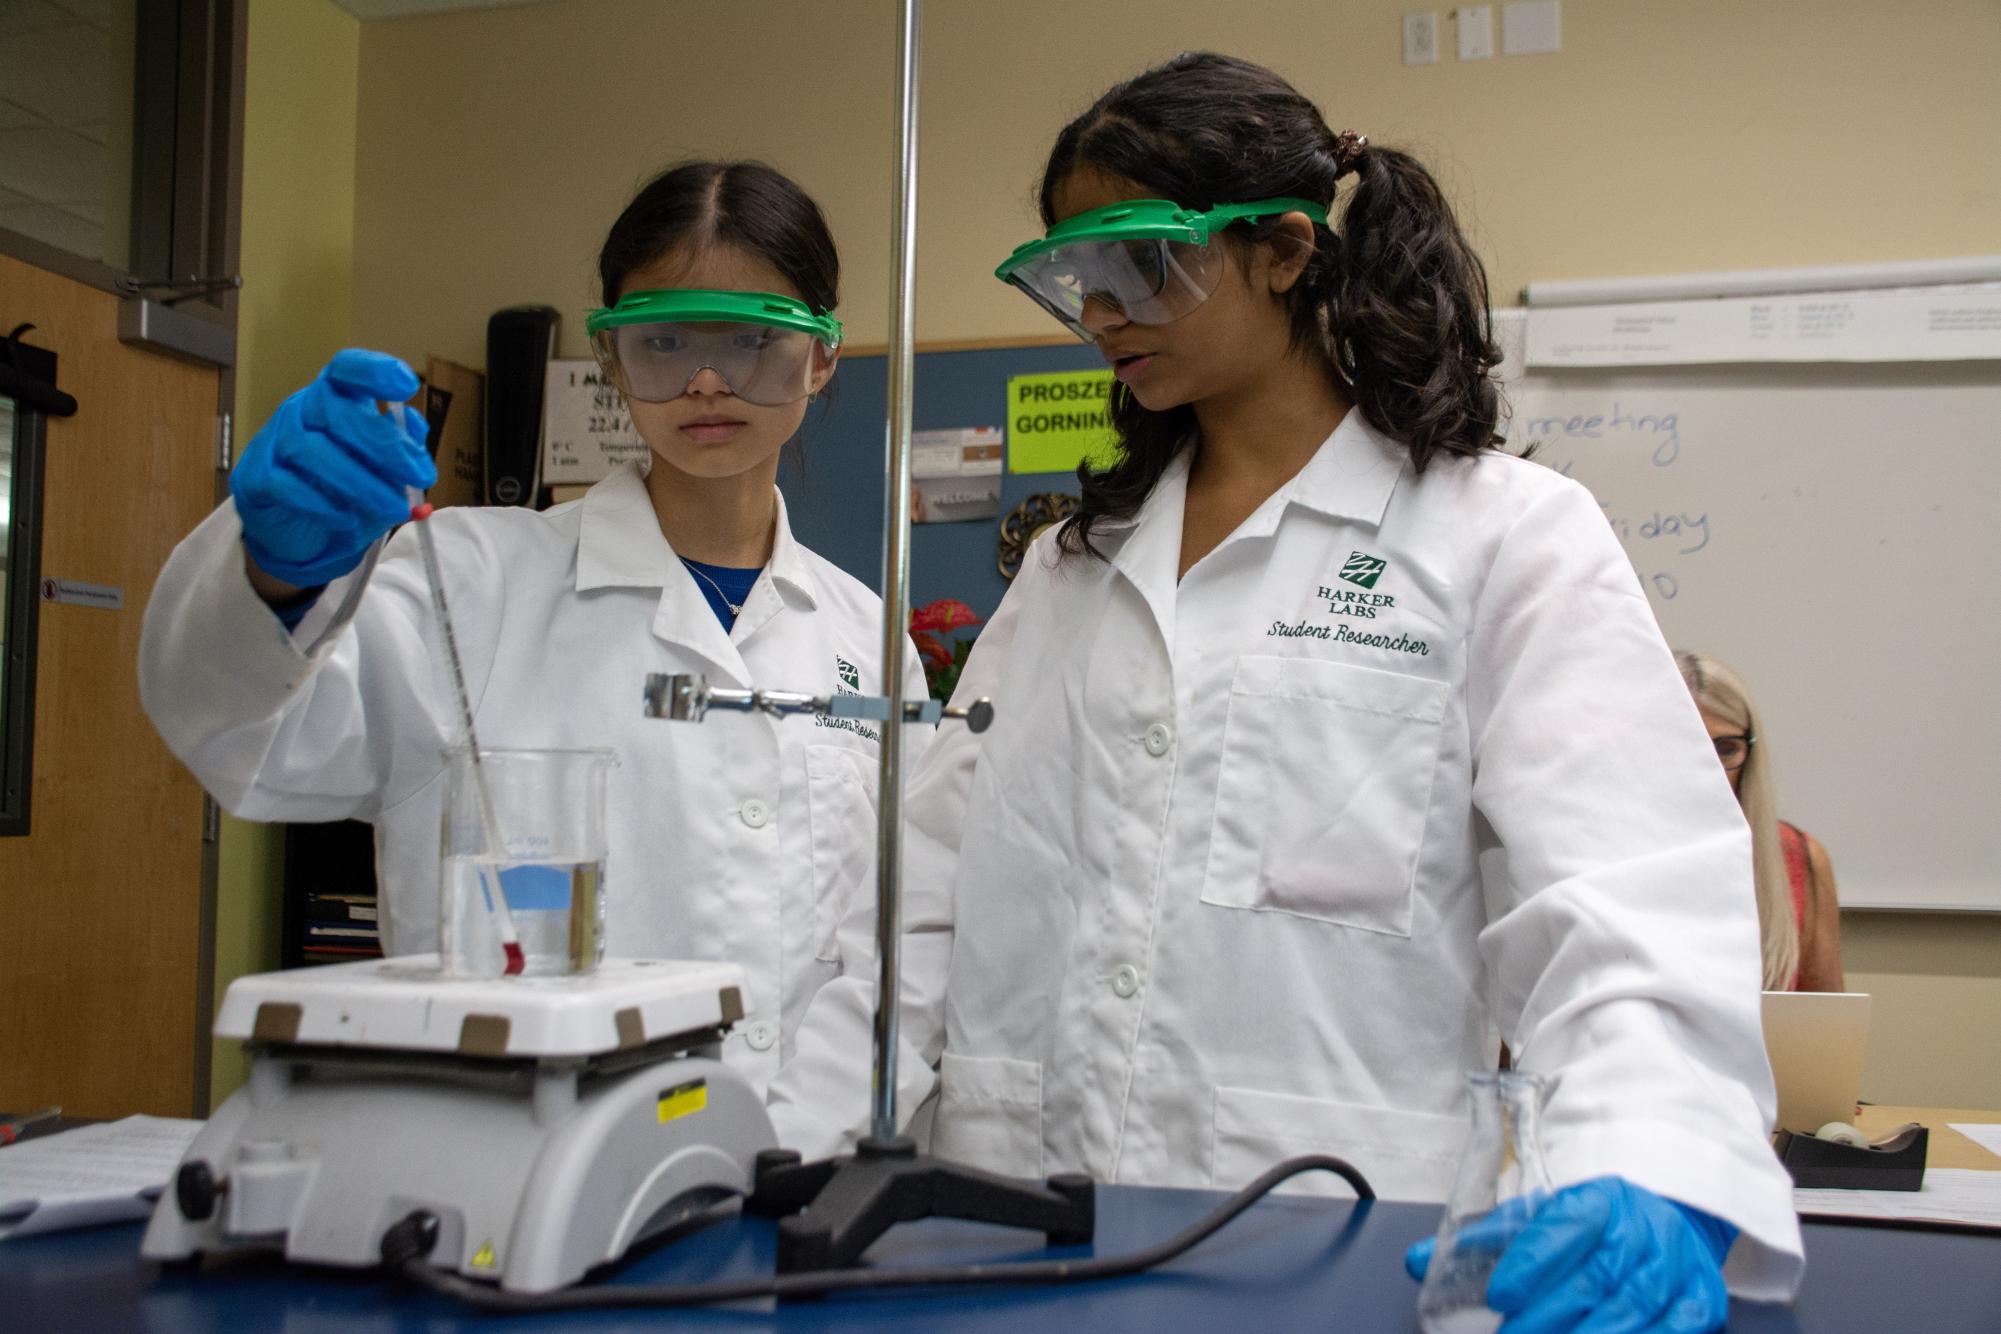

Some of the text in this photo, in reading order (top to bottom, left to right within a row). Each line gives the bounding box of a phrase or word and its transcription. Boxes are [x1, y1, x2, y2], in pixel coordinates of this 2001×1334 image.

[1020, 381, 1108, 403] PROSZE
[1527, 402, 1680, 468] meeting
[1602, 502, 1709, 555] iday
[1317, 586, 1396, 608] HARKER
[1328, 602, 1377, 619] LABS
[1267, 620, 1430, 657] Student Researcher
